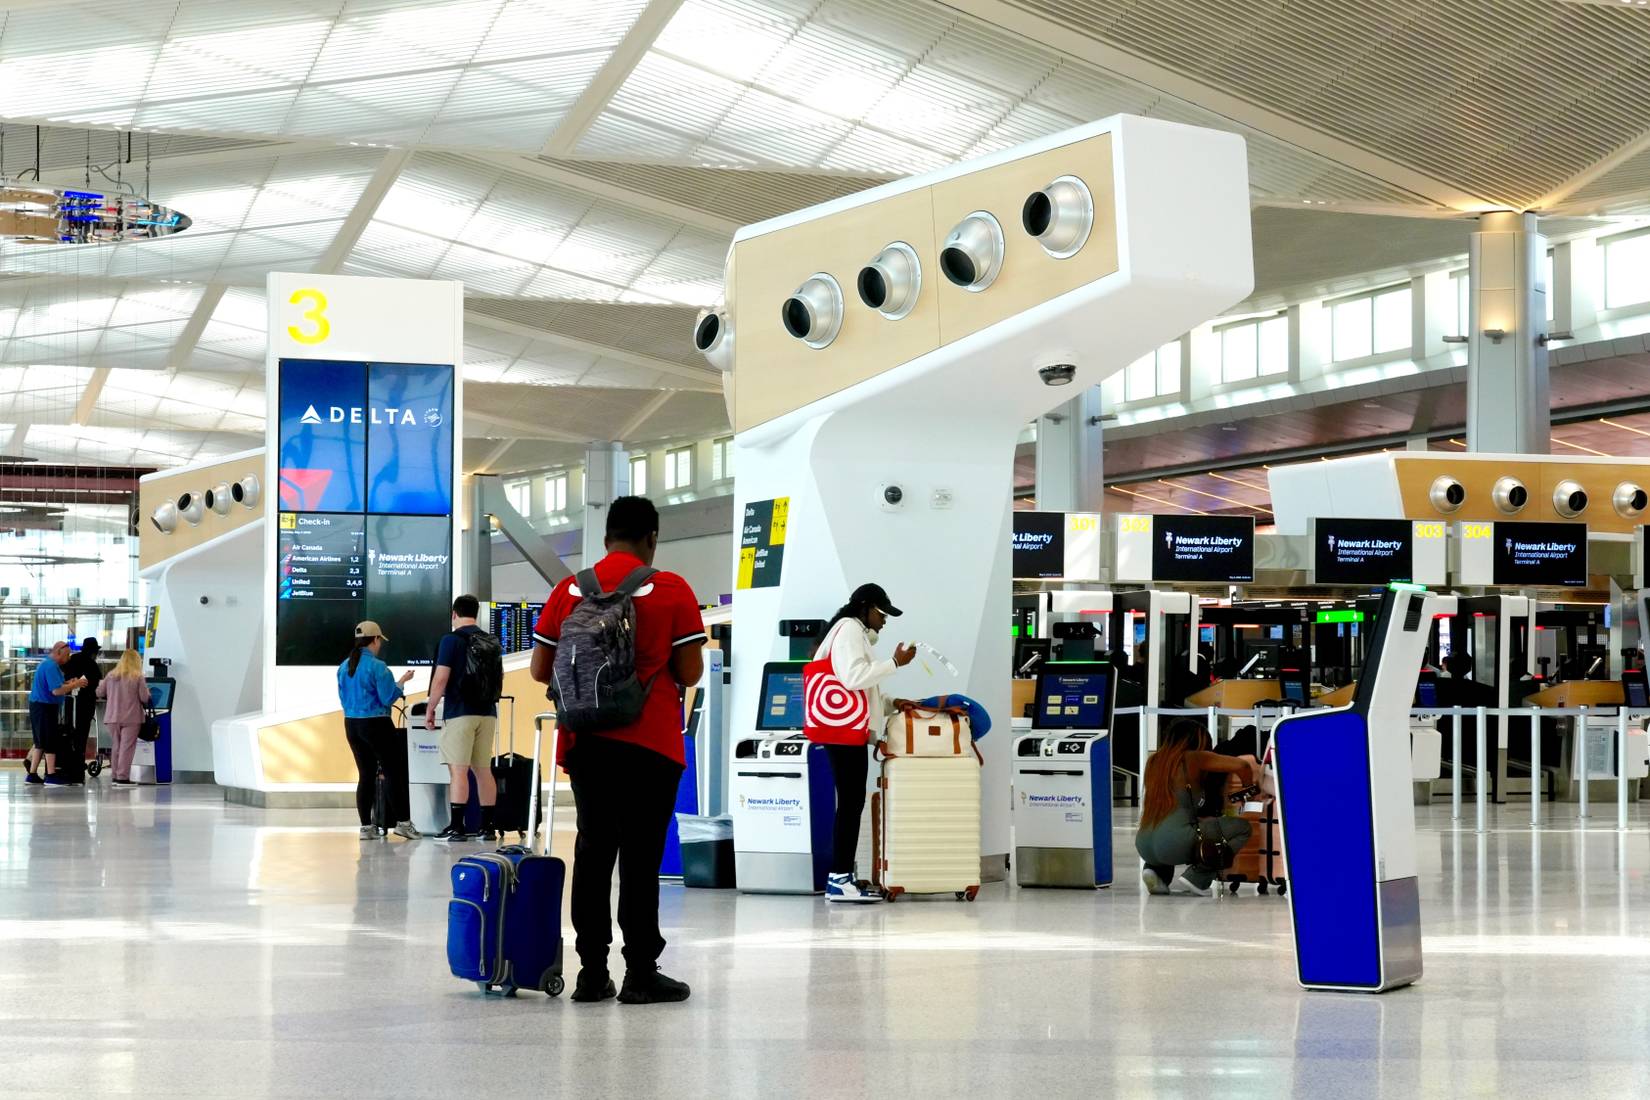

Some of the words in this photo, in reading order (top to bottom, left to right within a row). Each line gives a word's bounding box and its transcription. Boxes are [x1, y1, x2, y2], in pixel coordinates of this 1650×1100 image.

[287, 287, 331, 345] 3
[330, 406, 416, 425] DELTA
[298, 517, 331, 526] Check-in
[1121, 517, 1149, 532] 302
[1415, 524, 1443, 538] 303
[1464, 525, 1491, 539] 304
[1019, 533, 1053, 544] Liberty
[1175, 536, 1209, 545] Newark
[1210, 536, 1242, 547] Liberty
[1175, 545, 1213, 553] International
[1213, 546, 1233, 554] Airport
[1338, 539, 1370, 548] Newark
[1371, 540, 1402, 550] Liberty
[1515, 542, 1546, 551] Newark
[1547, 543, 1576, 553] Liberty
[1338, 548, 1374, 556] International
[1374, 549, 1393, 557] Airport
[1515, 551, 1549, 559] International
[1549, 552, 1568, 560] Airport
[379, 553, 414, 562] Newark
[415, 554, 448, 564] Liberty
[775, 798, 800, 807] Liberty
[1057, 795, 1082, 803] Liberty
